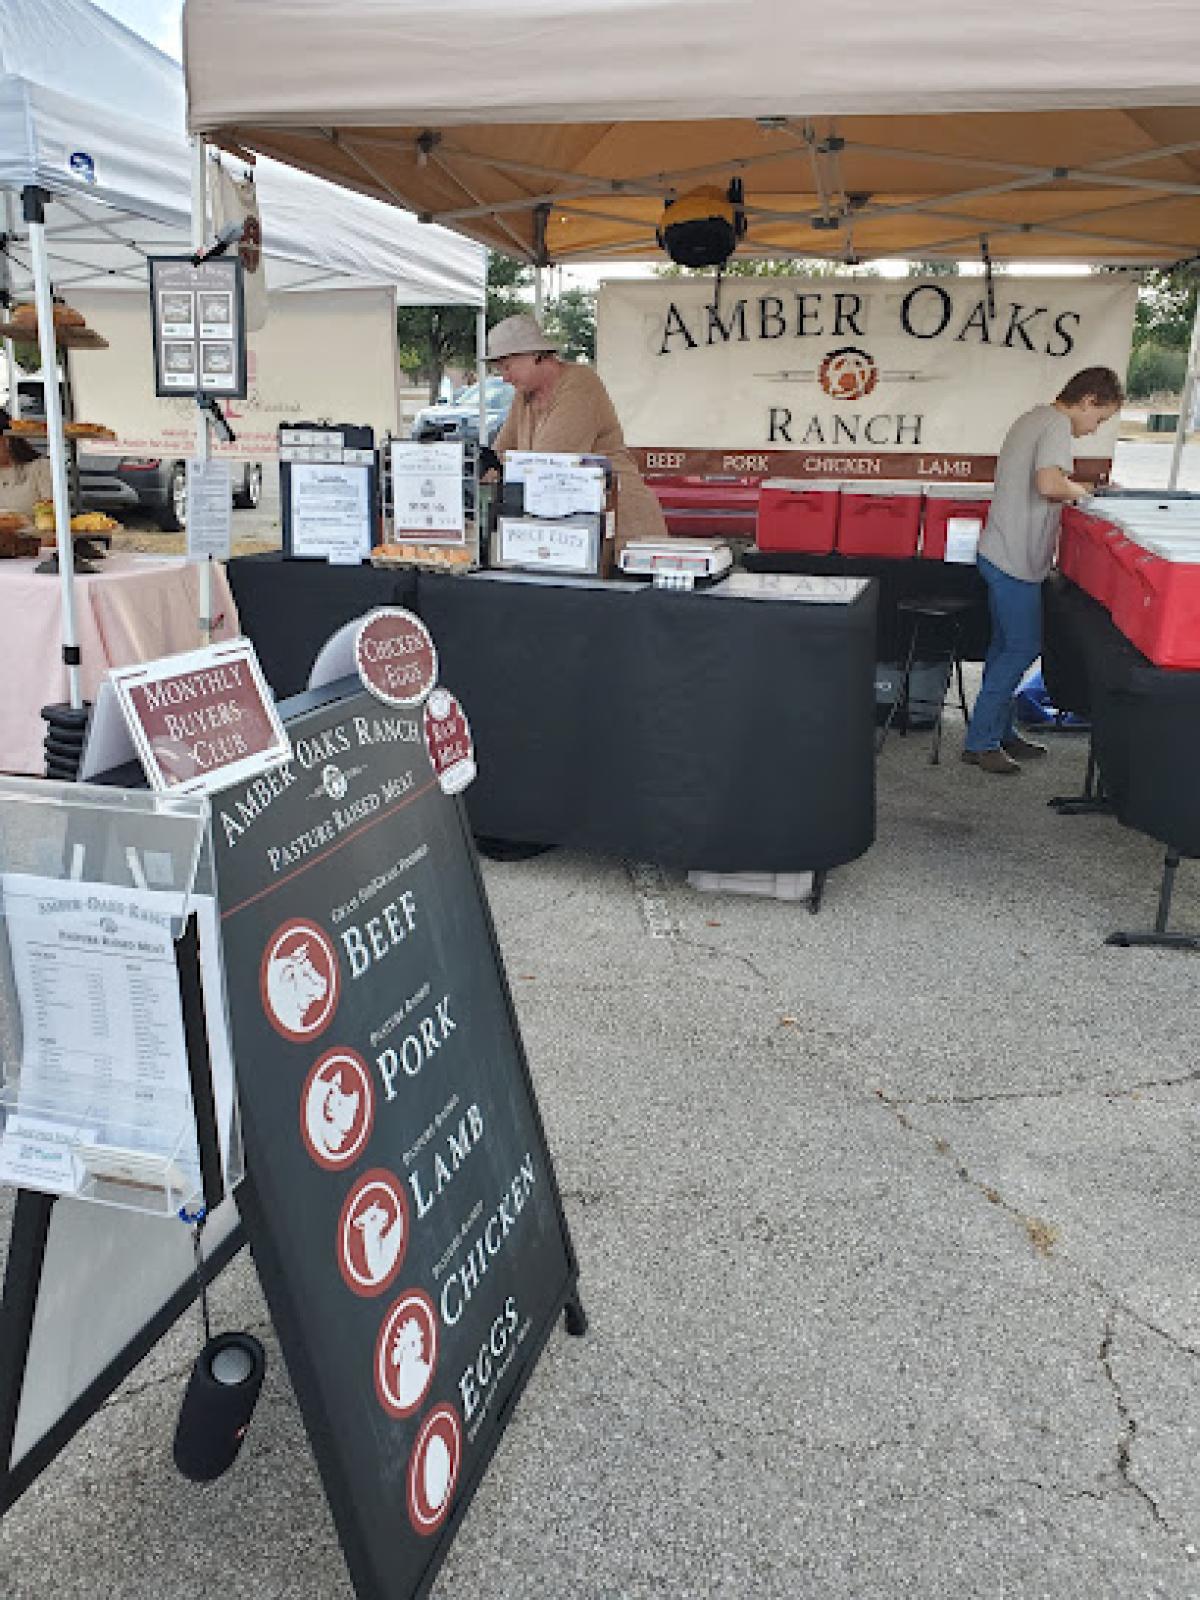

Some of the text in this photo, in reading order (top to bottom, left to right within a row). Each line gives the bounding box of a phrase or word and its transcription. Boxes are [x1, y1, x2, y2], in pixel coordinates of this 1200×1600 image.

[655, 283, 1081, 357] AMBER OAKS
[646, 452, 972, 476] BEEF PORK CHICKEN LAMB
[766, 407, 924, 446] RANCH
[142, 663, 244, 713] MONTHLY
[363, 632, 425, 663] CHICKEN
[163, 699, 244, 743] BUYERS
[191, 731, 249, 770] CLUB
[219, 716, 423, 848] AMBER OAKS RANCH
[266, 770, 415, 872] PASTURE RAISED MEAT
[340, 890, 417, 980] BEEF
[376, 994, 457, 1101] PORK
[408, 1103, 486, 1219] LAMB
[439, 1152, 537, 1327] CHICKEN
[458, 1296, 519, 1421] EGGS
